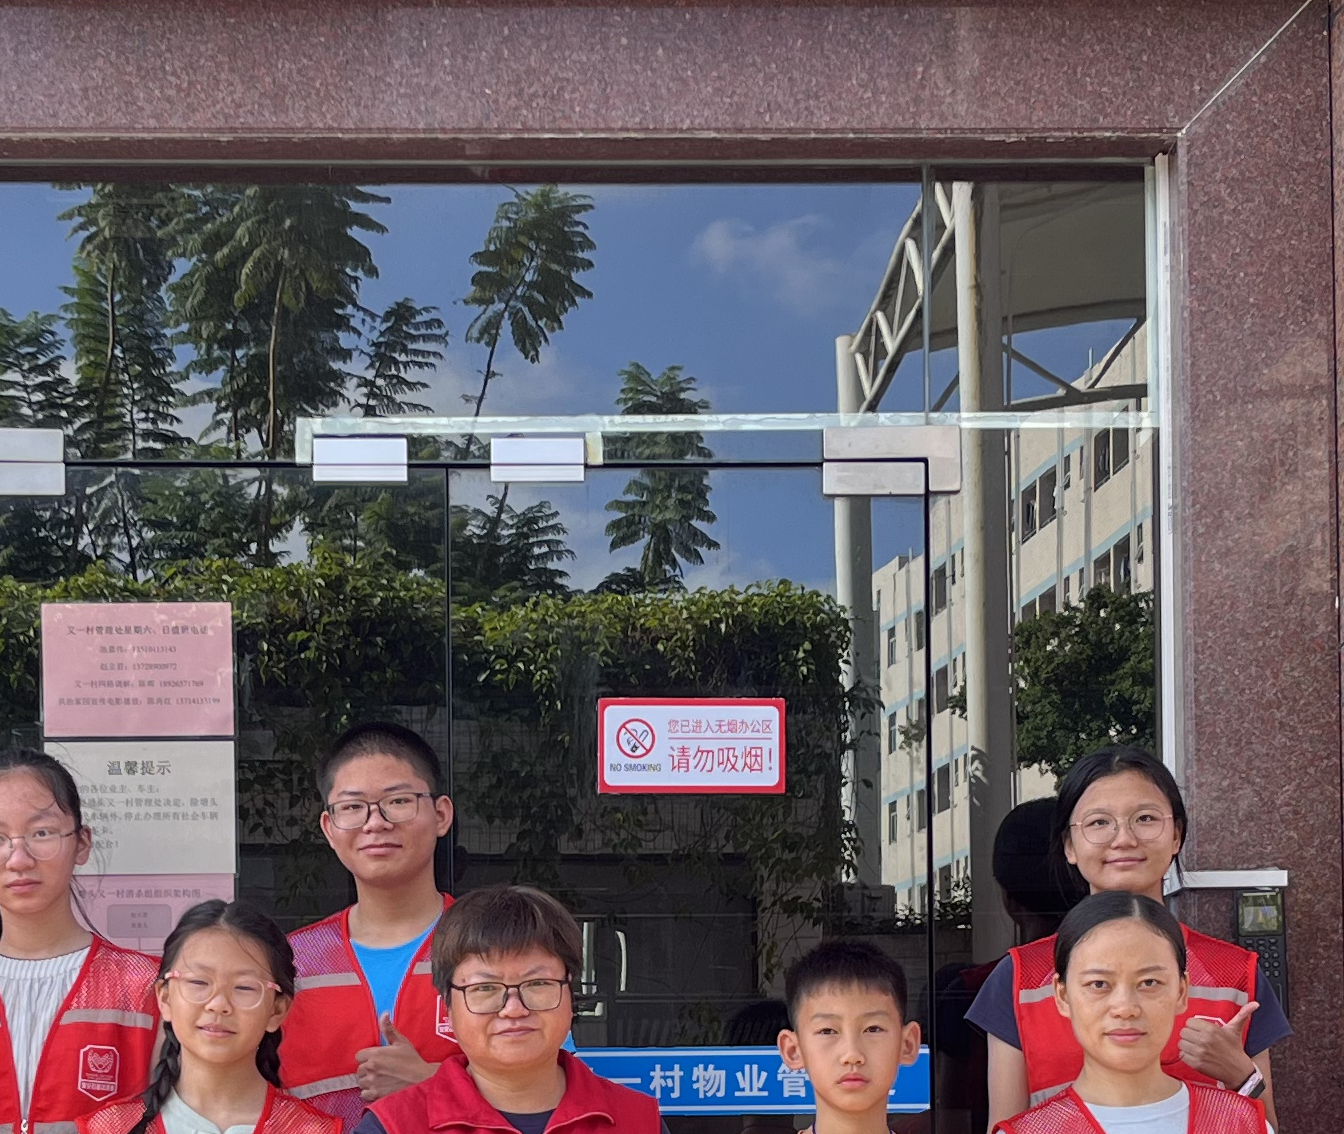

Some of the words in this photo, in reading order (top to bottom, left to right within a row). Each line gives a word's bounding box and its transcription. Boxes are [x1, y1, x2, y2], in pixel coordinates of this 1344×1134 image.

[667, 718, 773, 735] 您已进入无烟办公区
[107, 760, 172, 776] 温馨提示
[610, 763, 622, 773] NO
[623, 762, 662, 773] SMOKING
